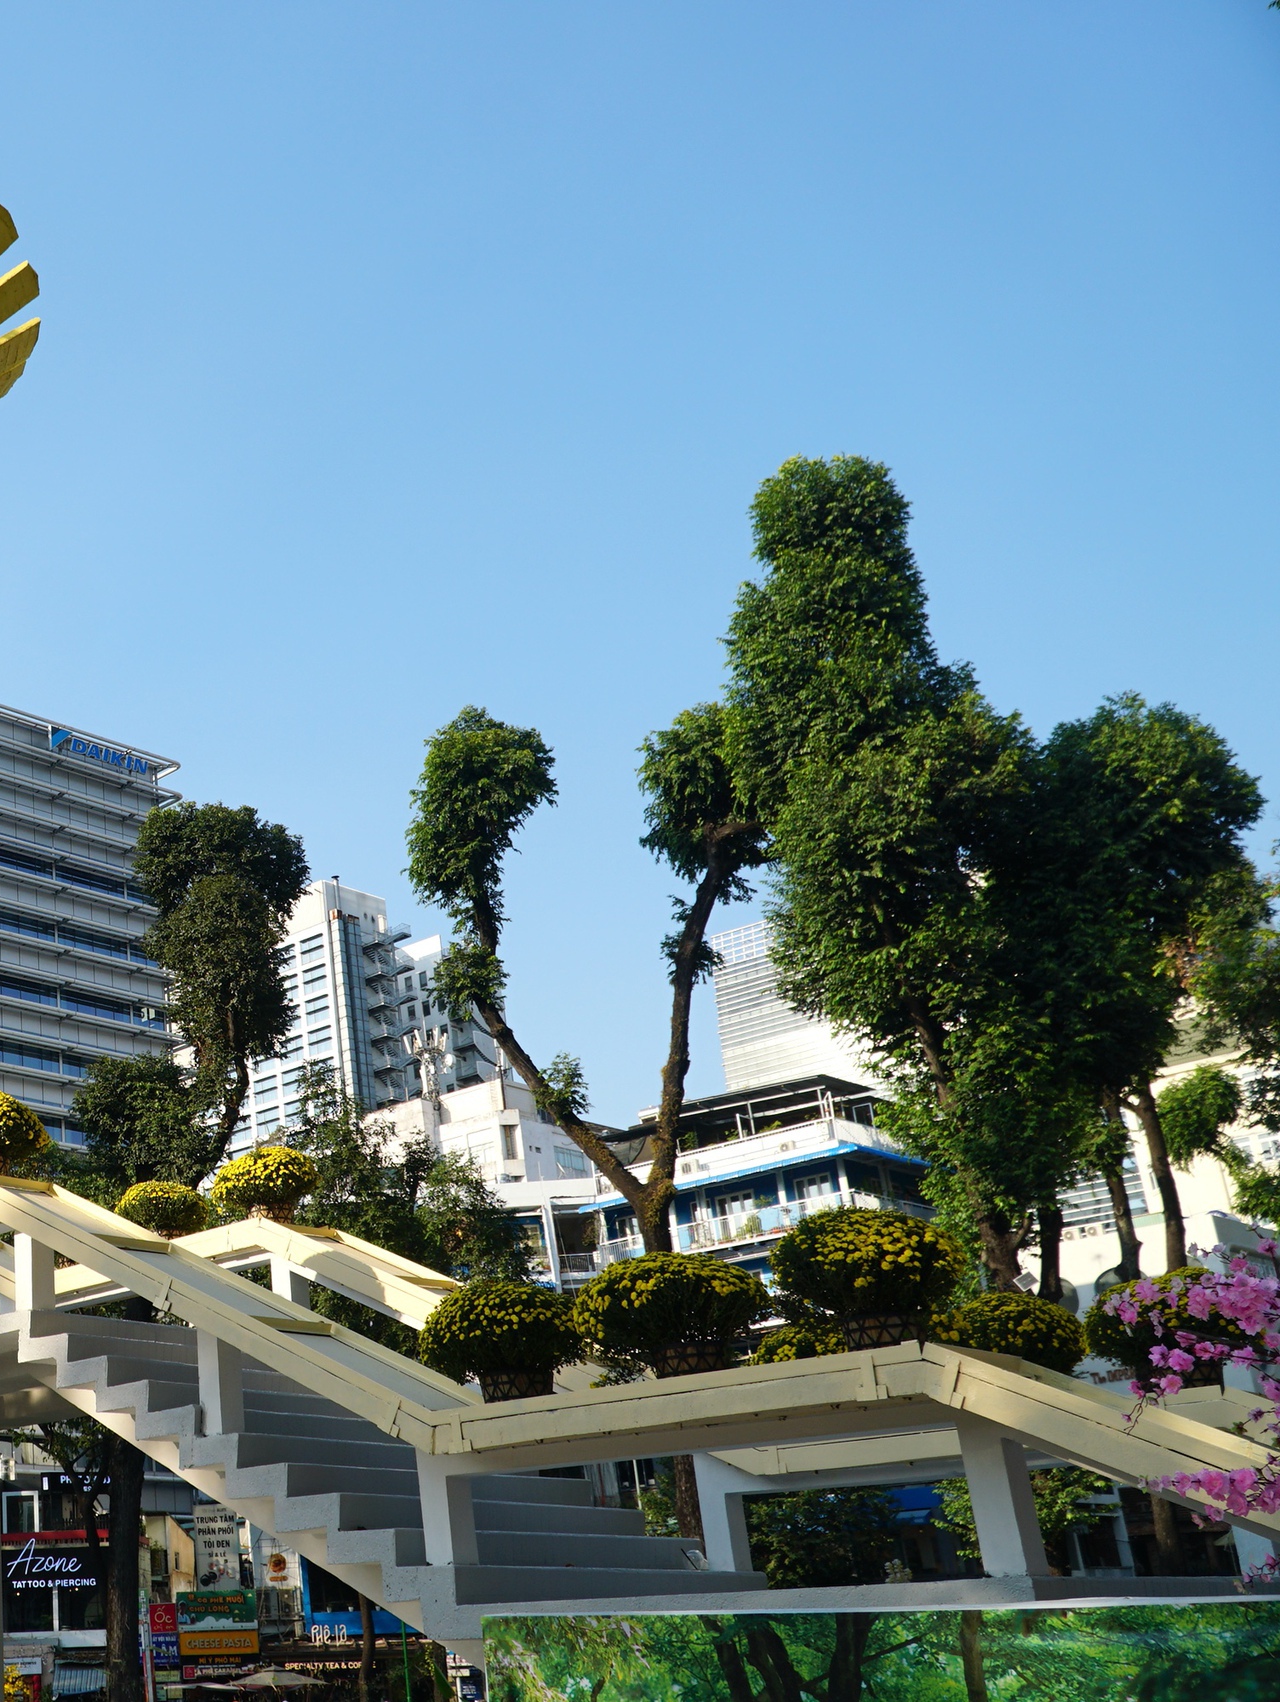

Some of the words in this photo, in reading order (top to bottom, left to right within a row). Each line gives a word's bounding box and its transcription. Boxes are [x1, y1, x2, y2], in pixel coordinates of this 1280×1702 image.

[71, 738, 148, 775] DAIKIN
[196, 1516, 218, 1525] TRUNG
[220, 1514, 235, 1524] TÂM
[198, 1526, 217, 1536] PHÂN
[218, 1524, 234, 1535] PHỐI
[7, 1538, 82, 1578] Azone
[12, 1580, 46, 1589] TATTOO
[47, 1579, 53, 1588] &
[55, 1578, 97, 1587] PIERCING
[186, 1640, 221, 1649] CHEESE
[223, 1638, 253, 1648] PASTA
[325, 1661, 339, 1669] TEA
[341, 1661, 347, 1669] &
